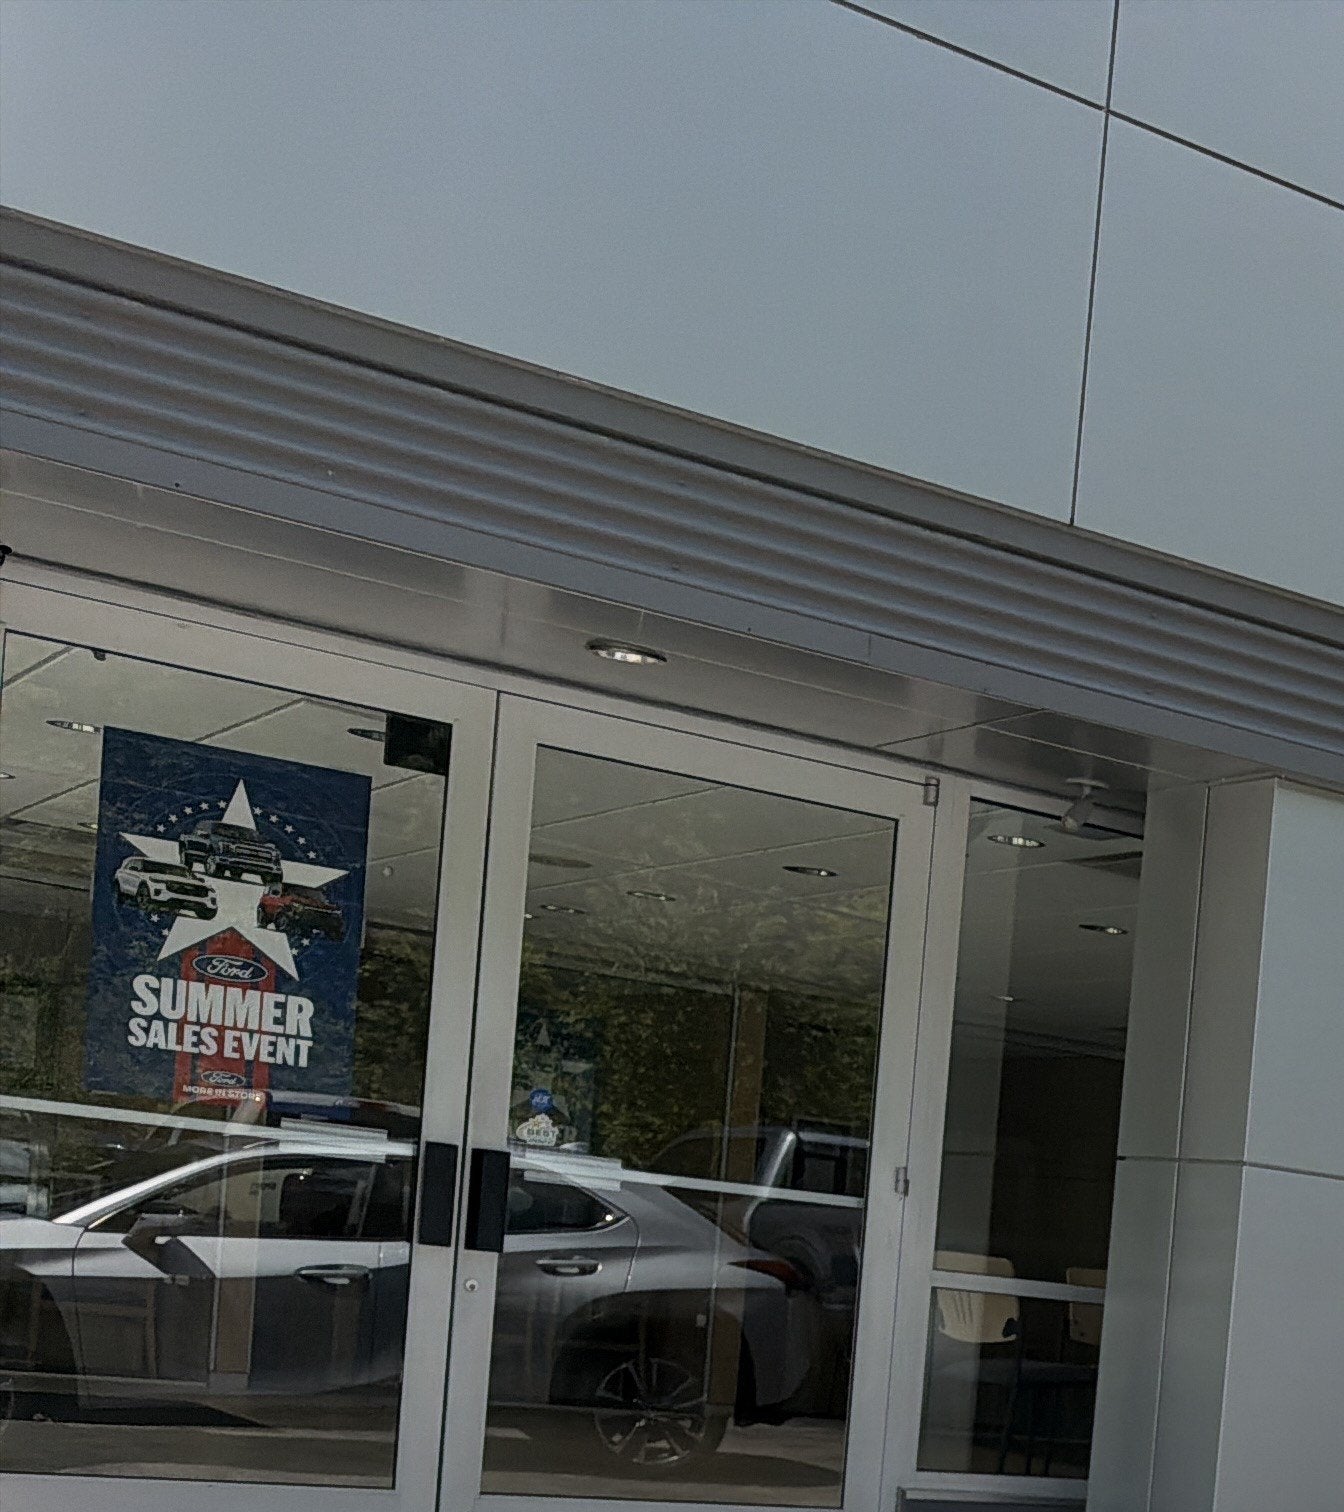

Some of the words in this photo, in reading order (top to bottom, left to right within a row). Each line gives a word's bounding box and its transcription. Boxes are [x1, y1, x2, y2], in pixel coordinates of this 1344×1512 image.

[207, 957, 252, 980] Ford
[131, 974, 314, 1037] SUMMER
[127, 1018, 218, 1056] SALES
[223, 1030, 313, 1068] EVENT
